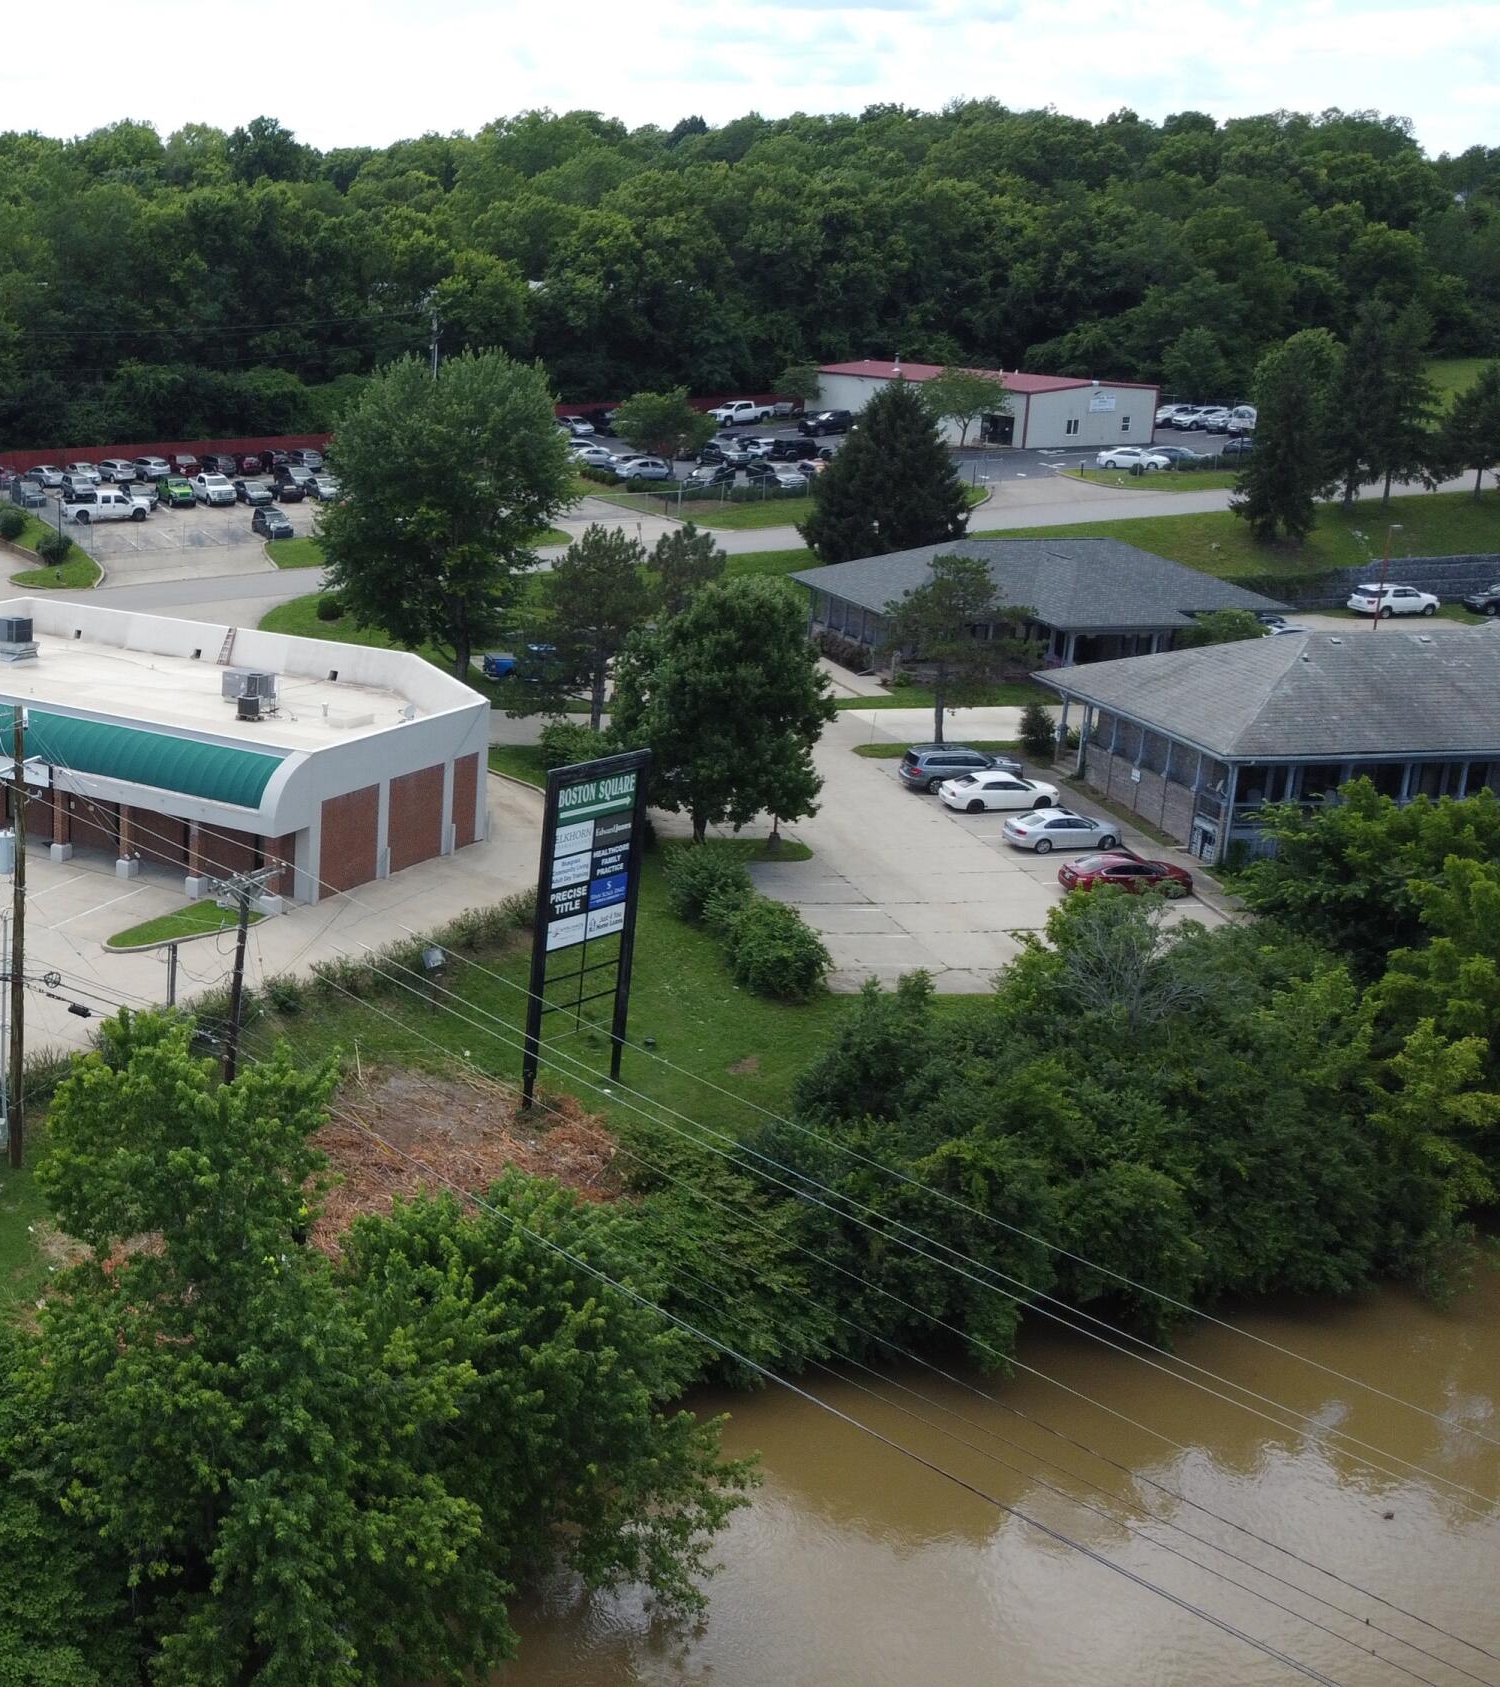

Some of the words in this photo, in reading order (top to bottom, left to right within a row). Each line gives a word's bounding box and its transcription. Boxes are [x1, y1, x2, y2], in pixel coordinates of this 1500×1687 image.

[558, 783, 596, 808] BOSTON
[598, 774, 636, 801] SQUARE
[555, 828, 592, 843] ELKHORN
[601, 854, 622, 866] FAMILY
[596, 863, 624, 876] PRACTICE
[550, 885, 588, 904] PRECISE
[555, 899, 581, 915] TITLE
